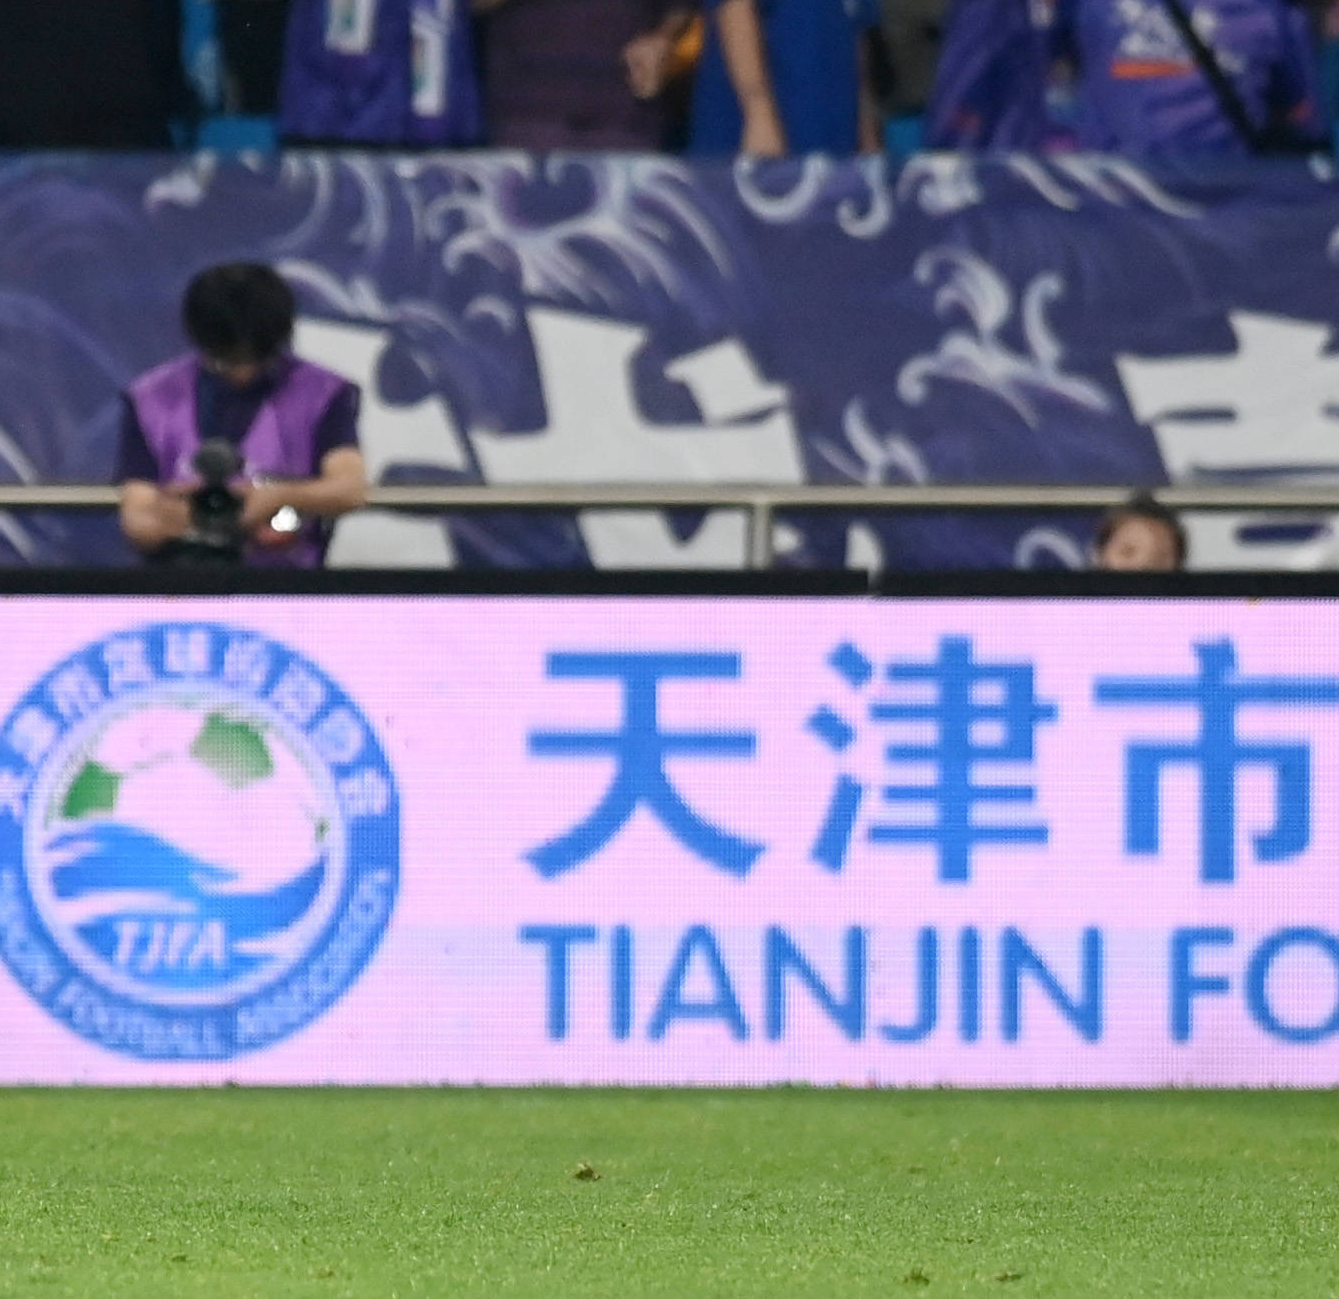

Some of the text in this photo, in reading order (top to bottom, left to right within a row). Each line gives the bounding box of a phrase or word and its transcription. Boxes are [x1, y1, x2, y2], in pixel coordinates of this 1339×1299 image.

[518, 632, 1339, 884] 天津市
[518, 923, 1104, 1043] TIANJIN
